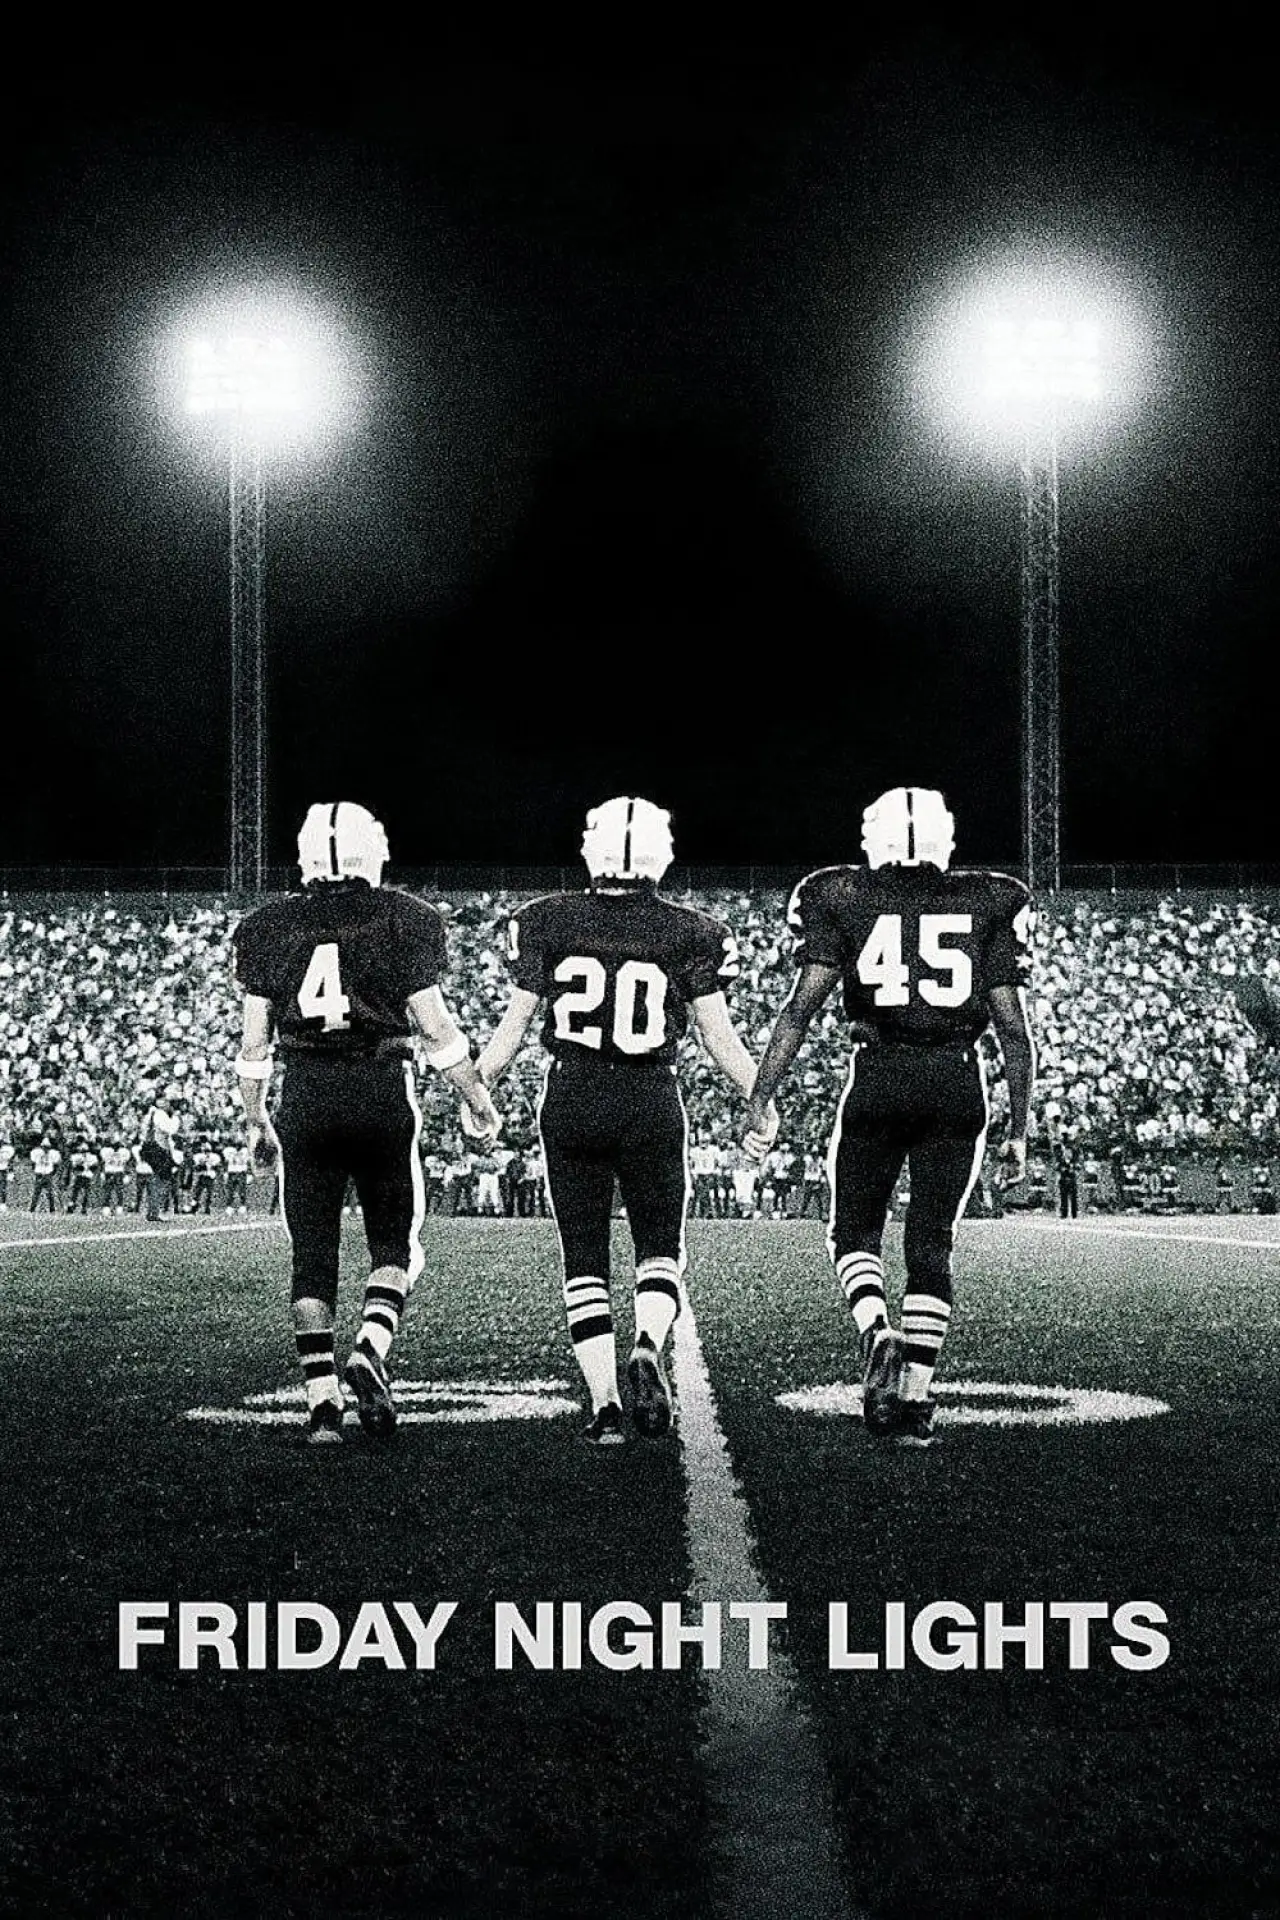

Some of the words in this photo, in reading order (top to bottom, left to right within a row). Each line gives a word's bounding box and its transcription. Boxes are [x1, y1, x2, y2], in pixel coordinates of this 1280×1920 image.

[297, 942, 351, 1033] 4
[552, 955, 669, 1055] 20
[856, 913, 973, 1008] 45
